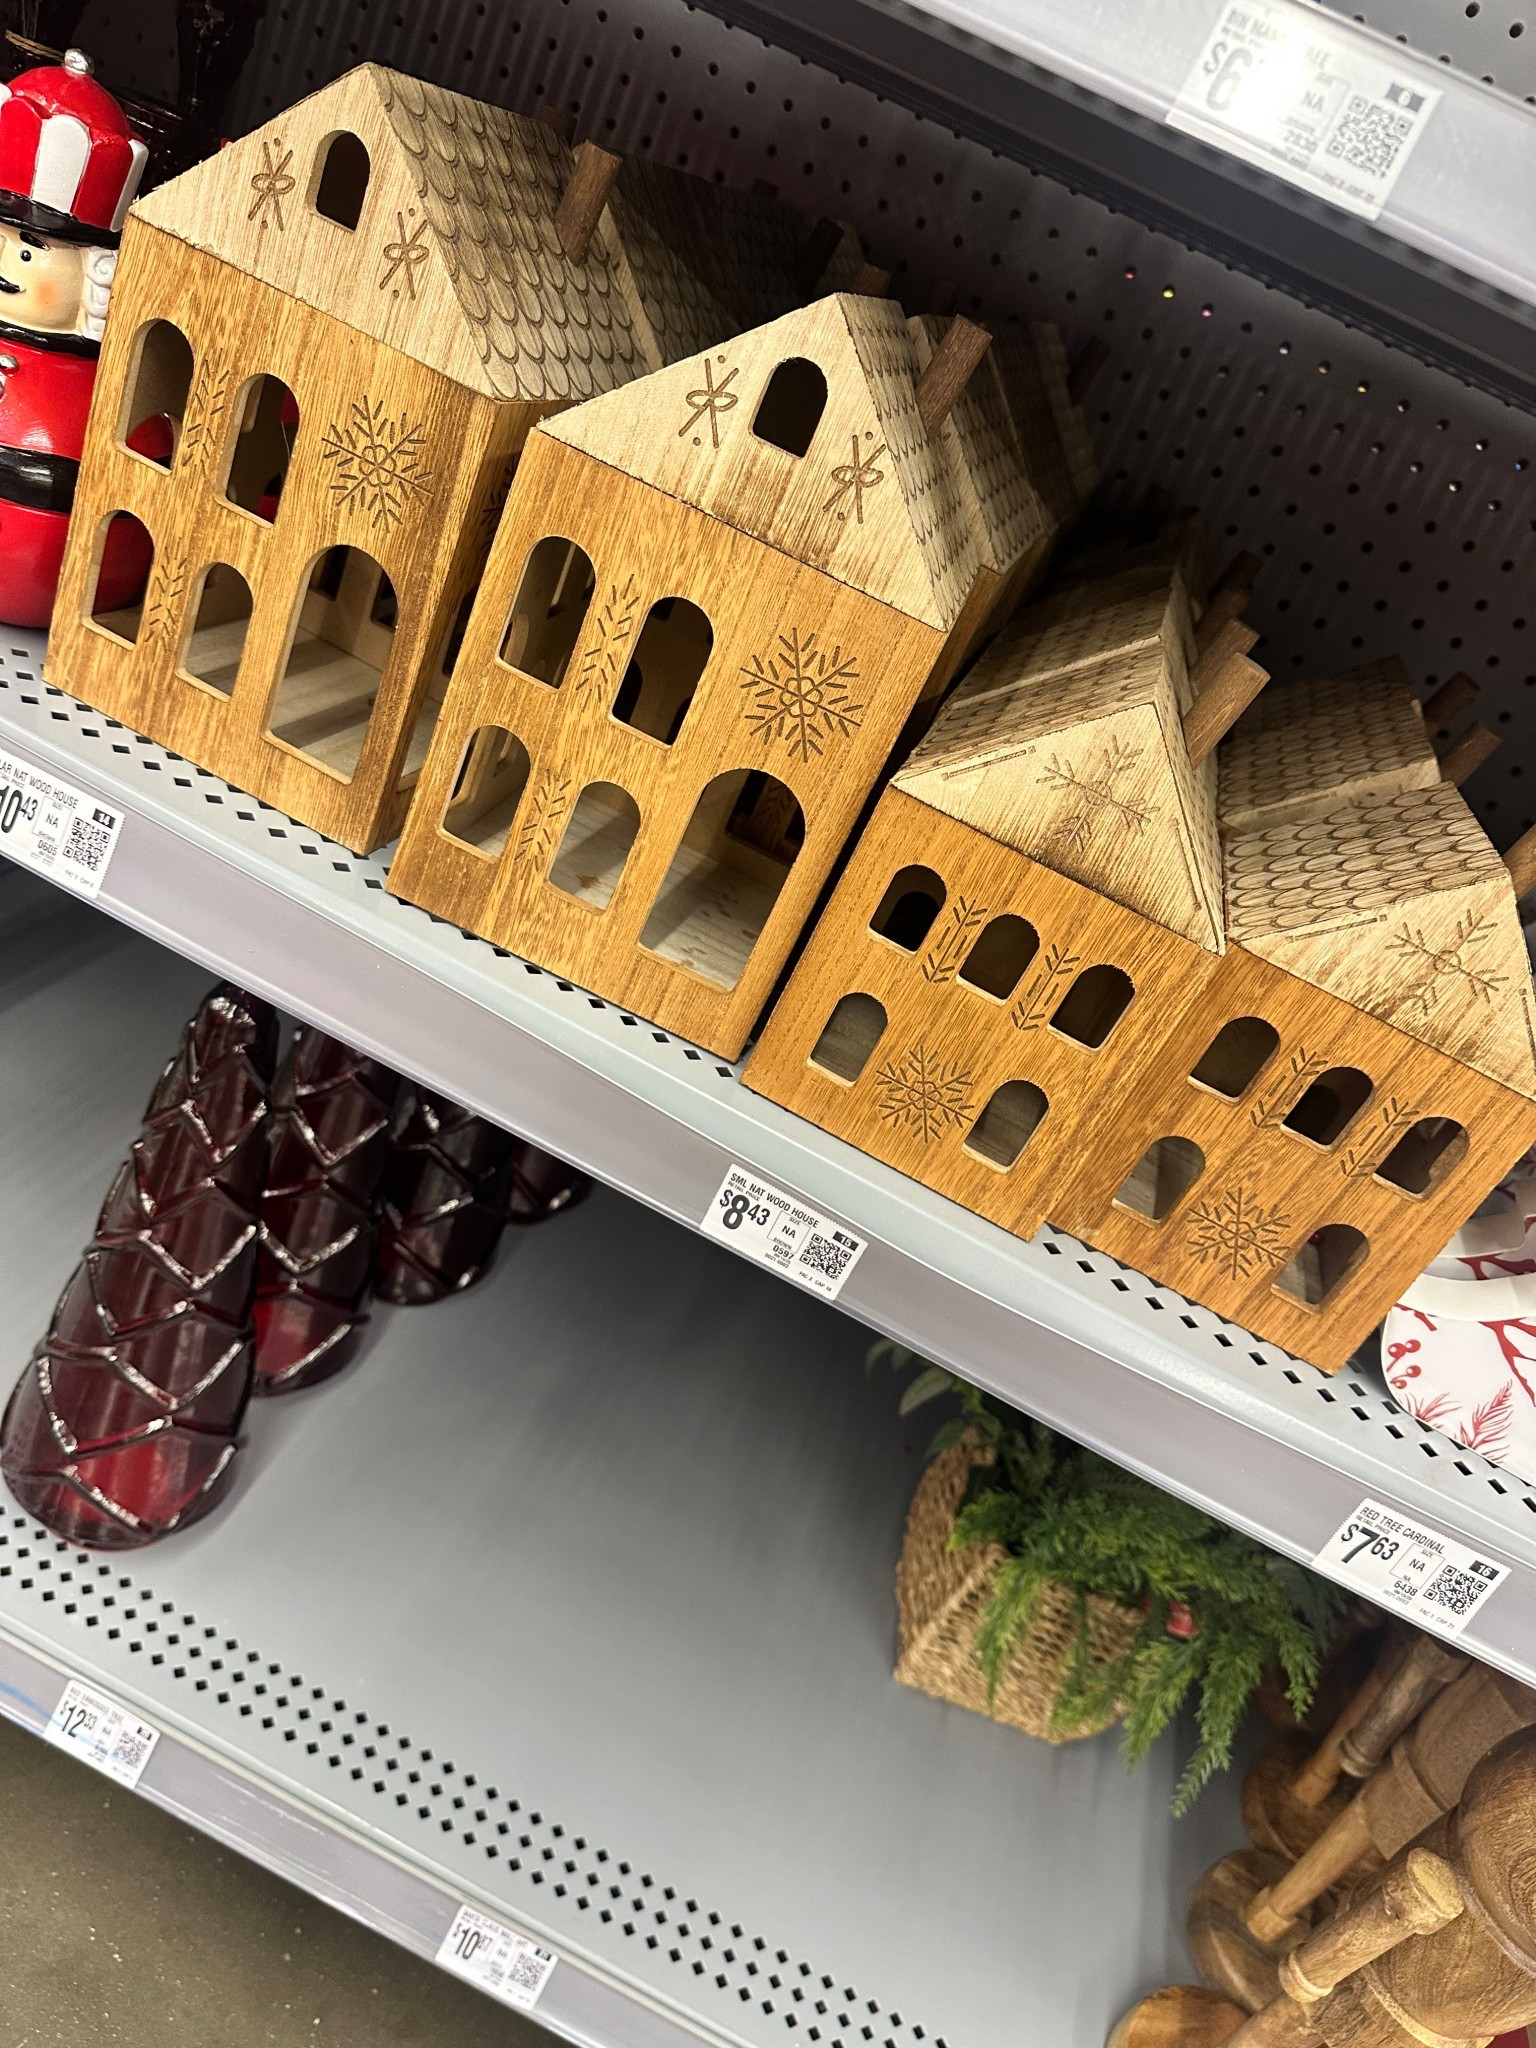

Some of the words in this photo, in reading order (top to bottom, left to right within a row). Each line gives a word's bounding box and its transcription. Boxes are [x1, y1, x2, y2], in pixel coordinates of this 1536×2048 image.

[14, 768, 28, 782] NAT
[29, 777, 52, 794] WOOD
[53, 788, 79, 809] HOUSE
[45, 814, 58, 828] NA
[99, 814, 110, 826] 14
[38, 839, 58, 856] 0605
[730, 1173, 746, 1188] SML
[750, 1183, 766, 1198] NAT
[766, 1192, 790, 1211] WOOD
[792, 1208, 820, 1228] HOUSE
[745, 1190, 760, 1202] PRICE
[789, 1216, 800, 1225] SIZE
[782, 1224, 796, 1238] NA
[773, 1237, 792, 1250] BROWN
[840, 1235, 852, 1247] 15
[772, 1244, 794, 1260] 0597
[1360, 1506, 1380, 1522] RED
[1381, 1516, 1404, 1533] TREE
[1403, 1528, 1446, 1554] CARDINAL
[1374, 1524, 1391, 1535] PRICE
[1420, 1549, 1434, 1557] SIZE
[1409, 1558, 1426, 1572] NA
[1478, 1563, 1492, 1577] 16
[1402, 1574, 1411, 1582] NA
[1394, 1580, 1418, 1597] 6438
[1436, 1616, 1448, 1625] CAP
